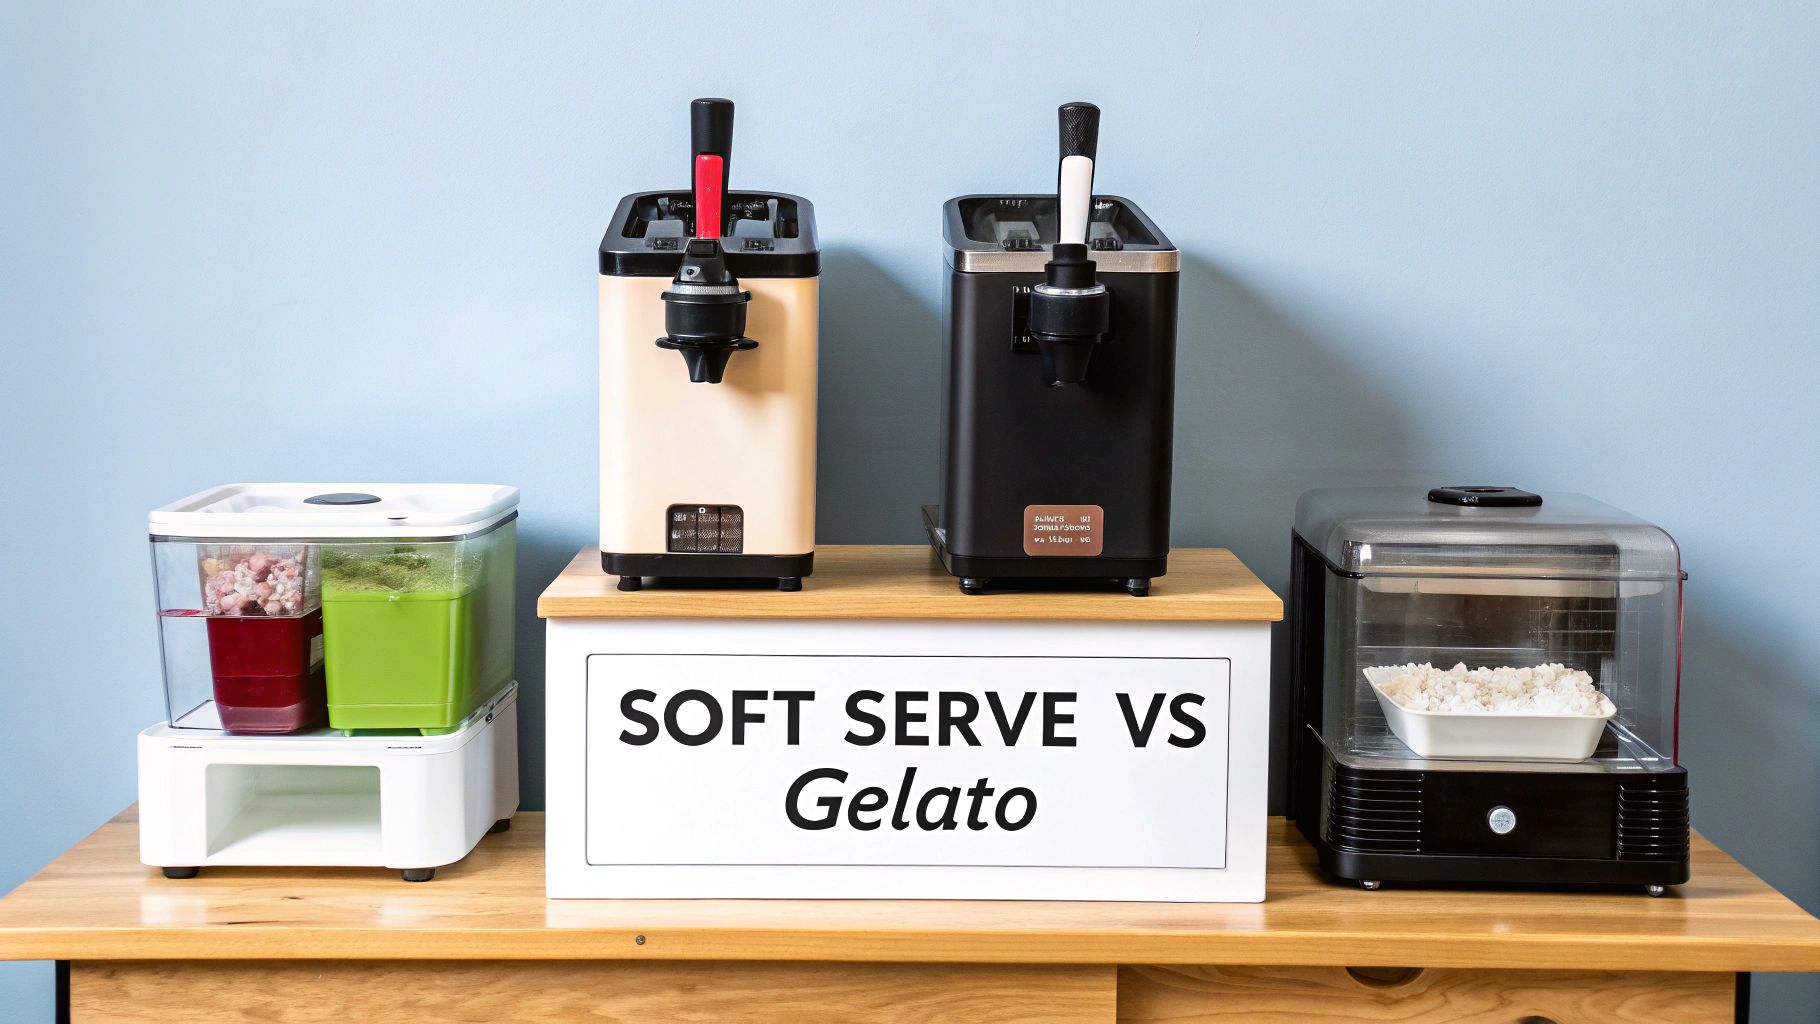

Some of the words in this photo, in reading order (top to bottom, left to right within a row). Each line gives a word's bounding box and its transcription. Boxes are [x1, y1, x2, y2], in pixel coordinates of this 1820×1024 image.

[619, 688, 816, 747] SOFT
[843, 689, 1078, 747] SERVE
[1115, 691, 1207, 749] VS
[785, 766, 1038, 832] Gelato
